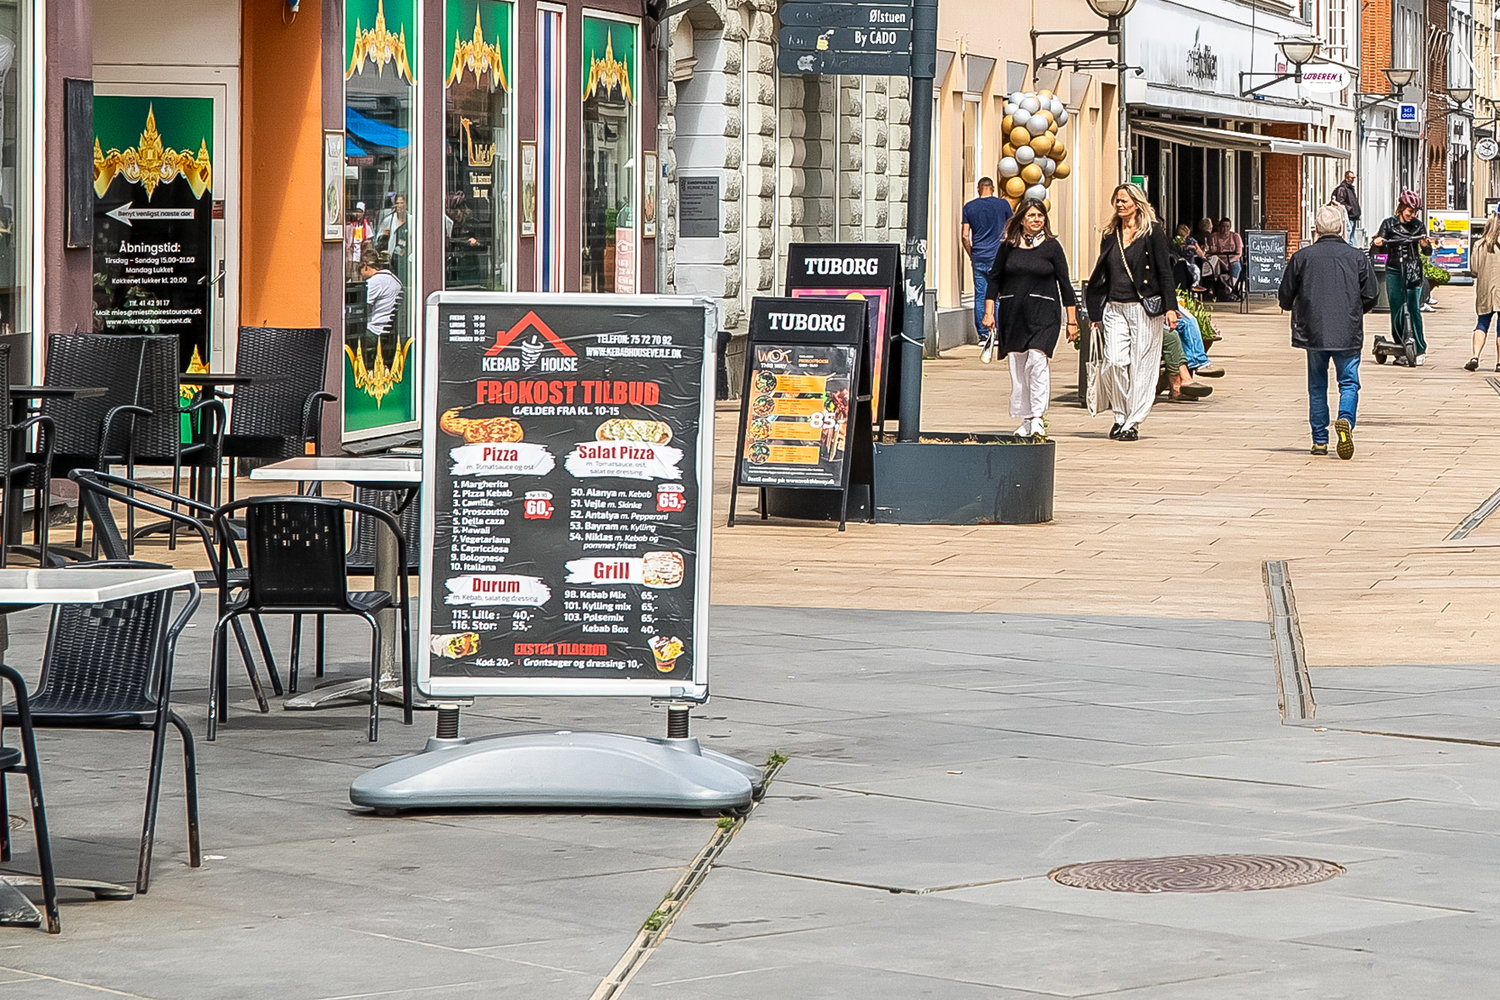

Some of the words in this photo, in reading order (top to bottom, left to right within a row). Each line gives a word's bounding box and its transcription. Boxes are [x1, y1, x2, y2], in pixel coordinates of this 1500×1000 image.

[870, 10, 906, 23] Ølstuen
[854, 31, 868, 48] By
[870, 31, 897, 44] CADO
[120, 240, 181, 255] Åbningstid:
[105, 257, 129, 265] Tirsdag
[804, 258, 878, 276] TUBORG
[768, 312, 846, 332] TUBORG
[630, 335, 640, 344] 75
[641, 335, 651, 344] 72
[652, 335, 661, 344] 70
[662, 335, 673, 345] 92
[482, 357, 520, 371] KEBAB
[541, 357, 578, 371] HOUSE
[476, 380, 577, 405] FROKOST
[581, 381, 660, 406] TILBUD
[512, 406, 555, 416] GÆLDER
[557, 406, 576, 416] FRA
[578, 406, 593, 416] KL.
[594, 406, 619, 416] 10-15
[483, 447, 518, 461] Pizza
[579, 446, 616, 459] Salat
[620, 446, 654, 459] Pizza
[461, 481, 509, 490] Margherita
[462, 490, 485, 498] Pizza
[486, 489, 513, 497] Kebab
[571, 488, 585, 496] 50.
[586, 489, 617, 499] Alanya
[628, 490, 652, 498] Kebab
[570, 499, 583, 508] 51.
[584, 500, 606, 509] Vejle
[659, 493, 686, 509] 65,-
[526, 500, 554, 516] 60,-
[570, 510, 583, 519] 52.
[585, 510, 619, 521] Antalya
[570, 521, 583, 530] 53.
[584, 522, 618, 531] Bayram
[584, 532, 613, 541] Niklas
[594, 562, 630, 580] Grill
[472, 578, 520, 593] Durum
[564, 591, 578, 599] 98.
[580, 591, 607, 599] Kebab
[610, 591, 626, 600] Mix
[641, 591, 658, 601] 65,-
[564, 602, 580, 610] 101.
[582, 602, 610, 612] Kylling
[612, 603, 631, 611] mix
[641, 602, 658, 612] 65,-
[452, 610, 470, 619] 115.
[512, 611, 535, 620] 40,-
[564, 613, 581, 621] 103.
[583, 614, 624, 622] Pølsemix
[641, 614, 658, 623] 65,-
[451, 621, 470, 630] 116.
[472, 622, 497, 630] Stor:
[512, 622, 533, 631] 55,-
[582, 625, 610, 633] Kebab
[612, 625, 628, 633] Box
[641, 625, 659, 634] 40,-
[573, 660, 585, 669] og
[627, 660, 643, 669] 10,-
